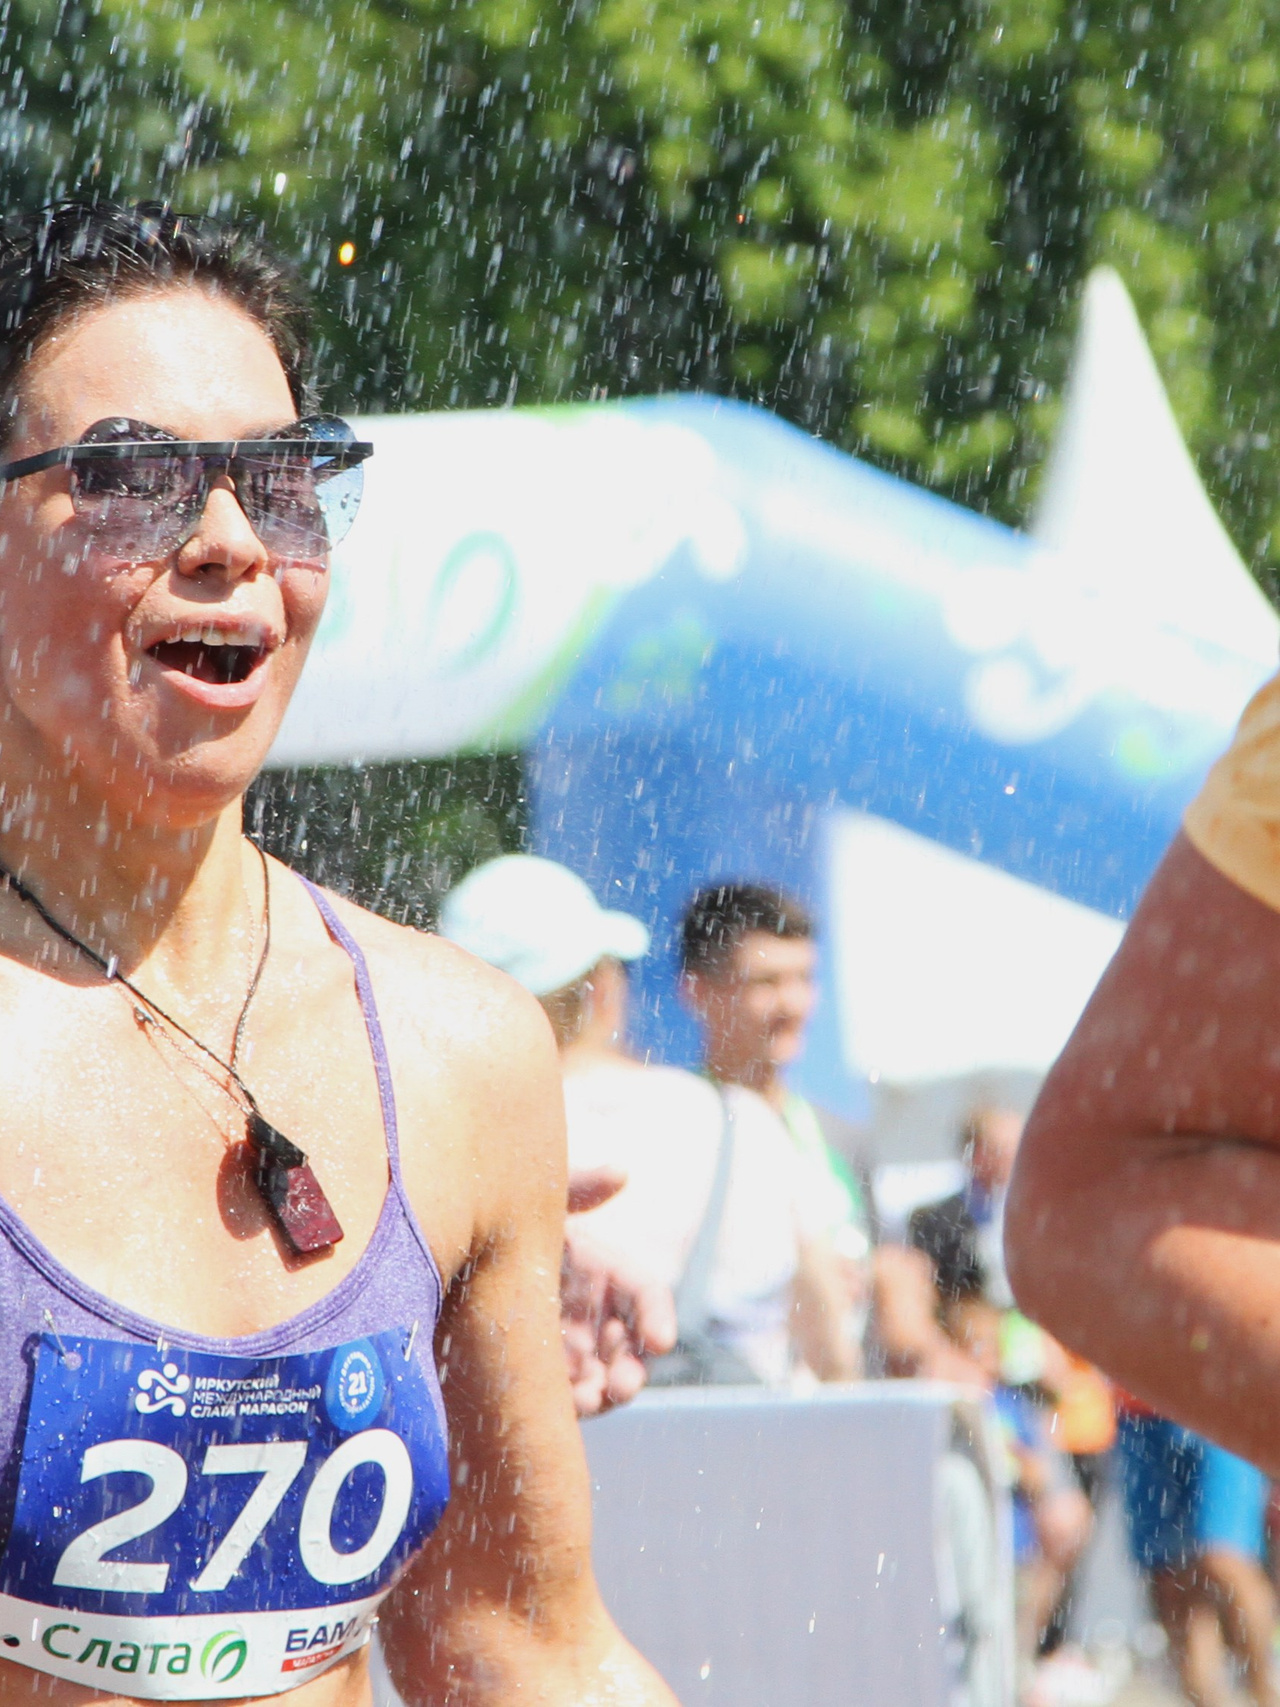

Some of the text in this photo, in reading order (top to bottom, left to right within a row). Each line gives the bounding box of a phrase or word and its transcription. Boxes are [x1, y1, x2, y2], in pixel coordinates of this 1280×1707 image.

[194, 1373, 280, 1392] ИРКУТСКИЙ
[348, 1370, 368, 1396] 21
[190, 1401, 309, 1418] СЛАТА МАРАФОН
[52, 1428, 414, 1594] 270
[41, 1623, 191, 1675] Слата
[285, 1616, 363, 1653] БАМ
